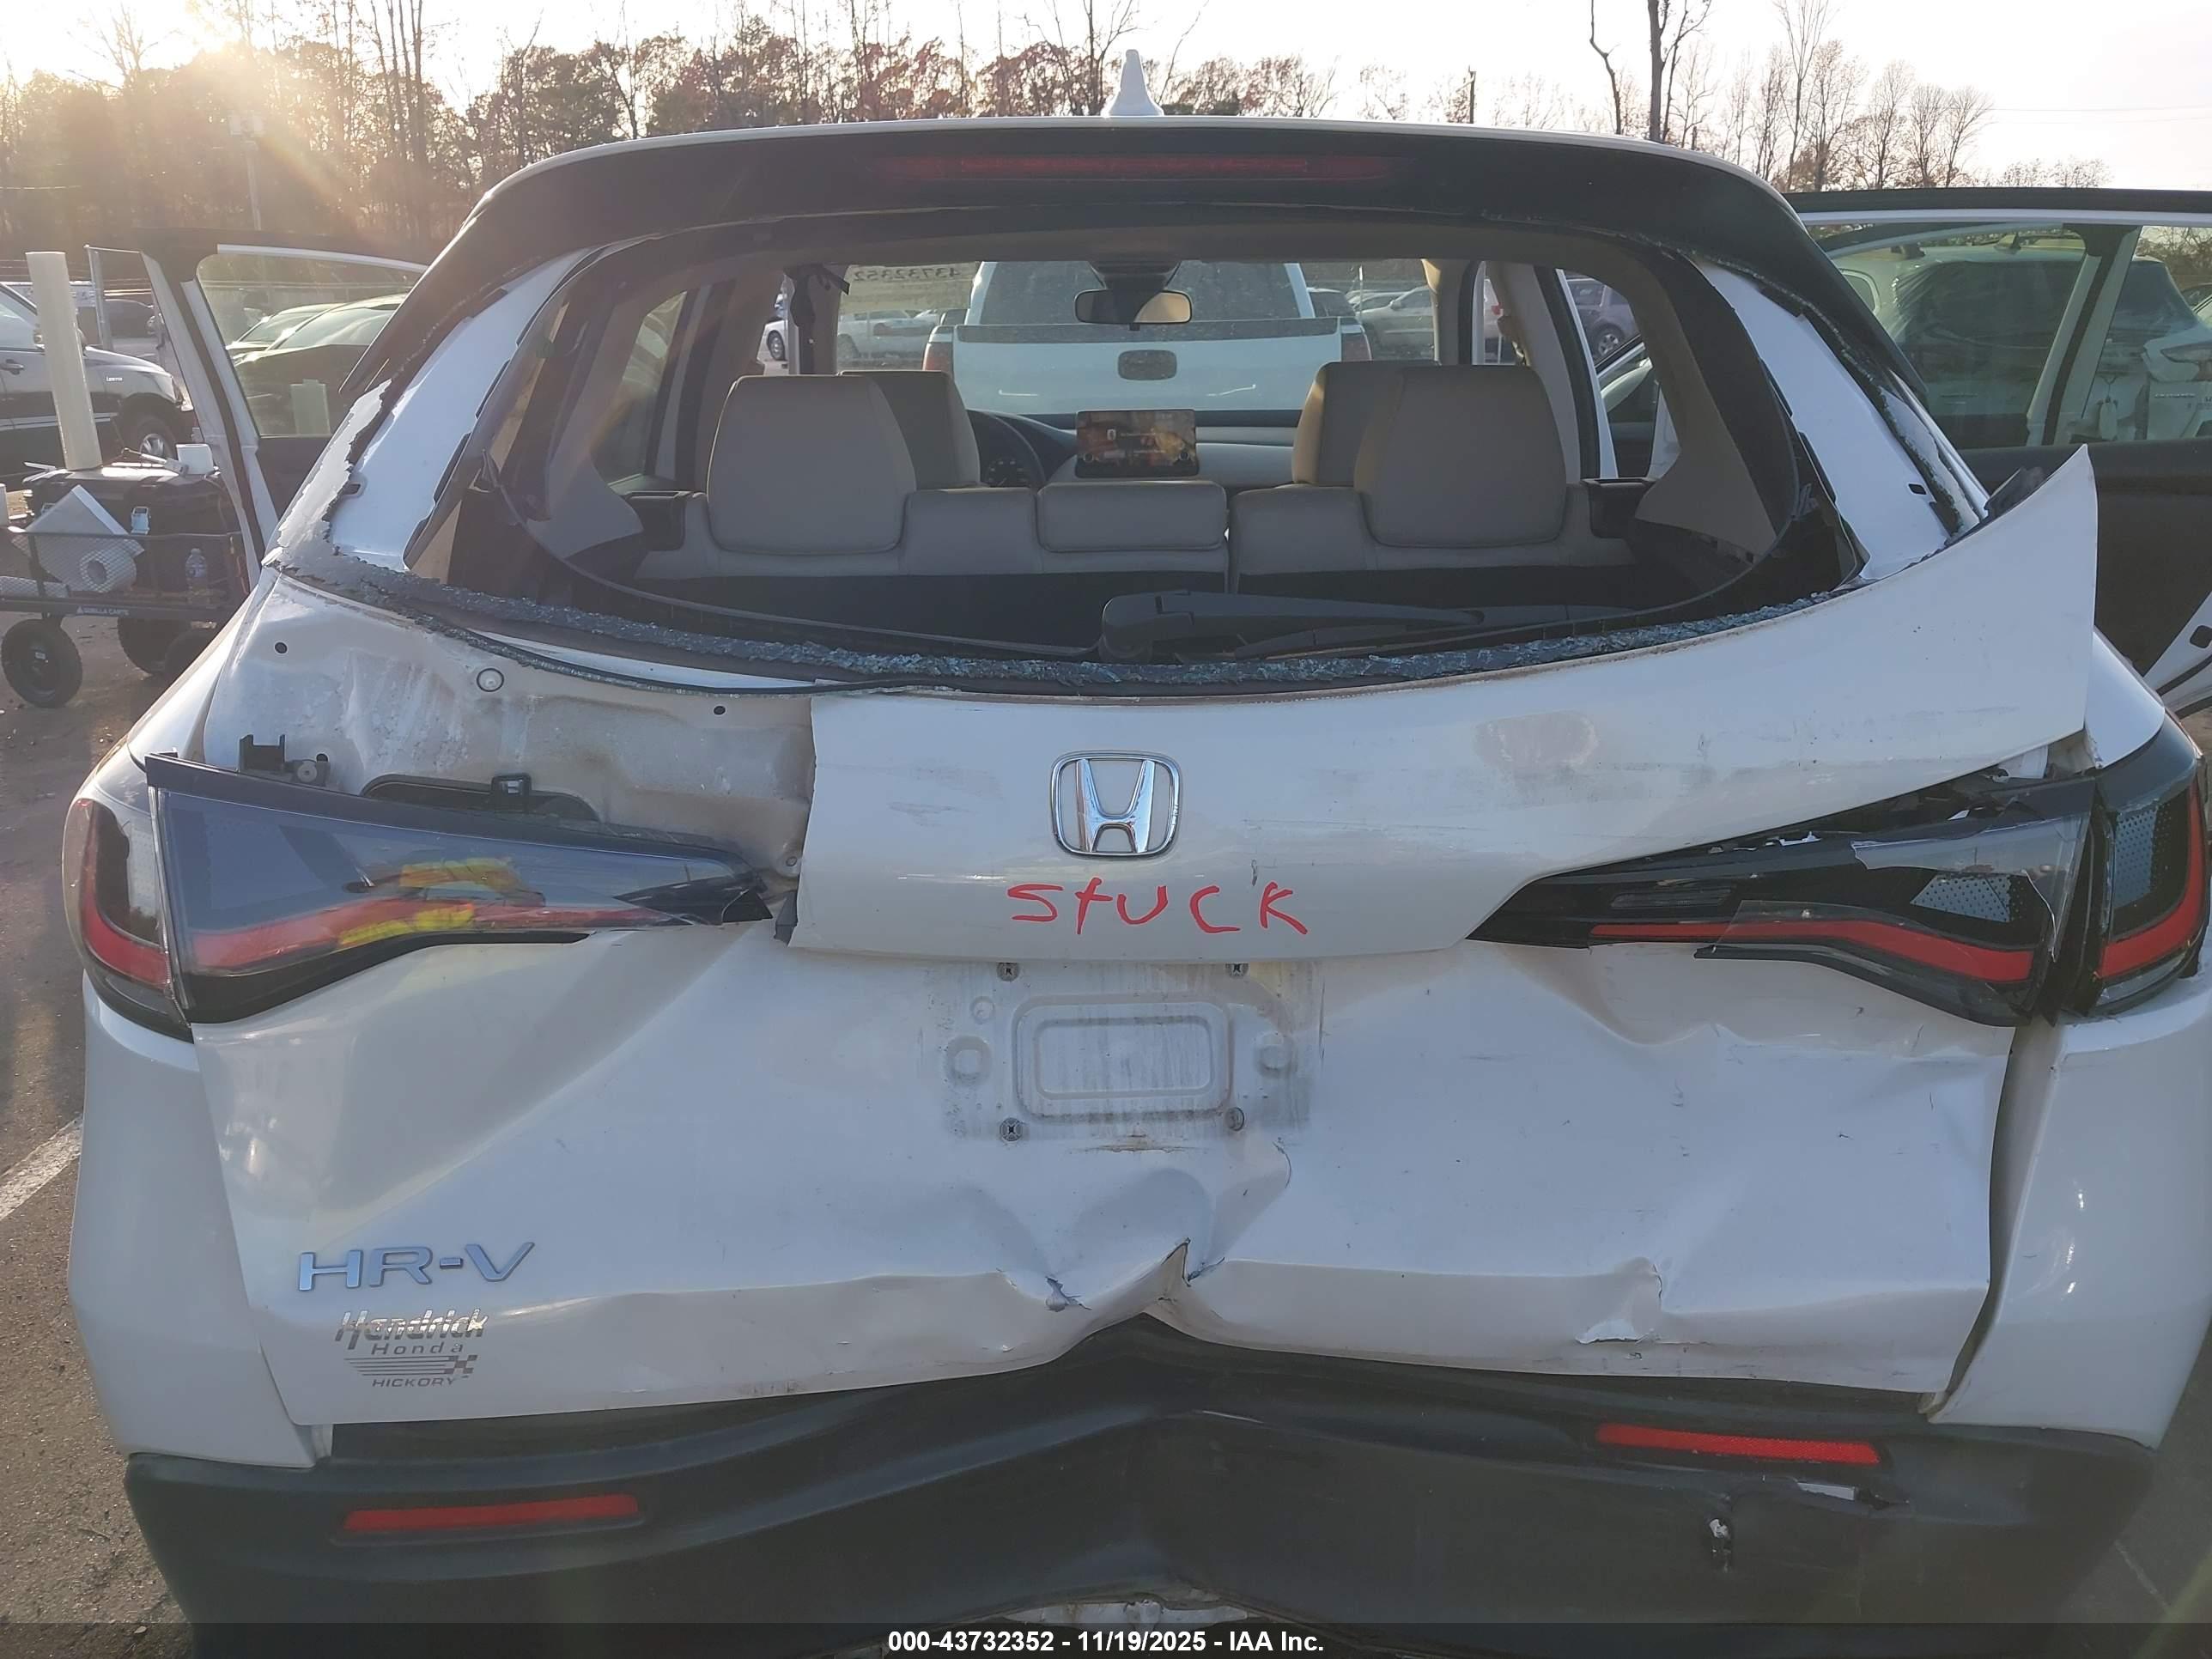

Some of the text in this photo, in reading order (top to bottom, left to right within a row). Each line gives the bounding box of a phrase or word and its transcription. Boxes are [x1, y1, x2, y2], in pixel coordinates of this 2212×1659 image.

[298, 1242, 536, 1291] HR-V
[335, 1308, 488, 1351] Hendrick
[371, 1340, 464, 1356] Honda
[372, 1376, 456, 1388] HICKORY
